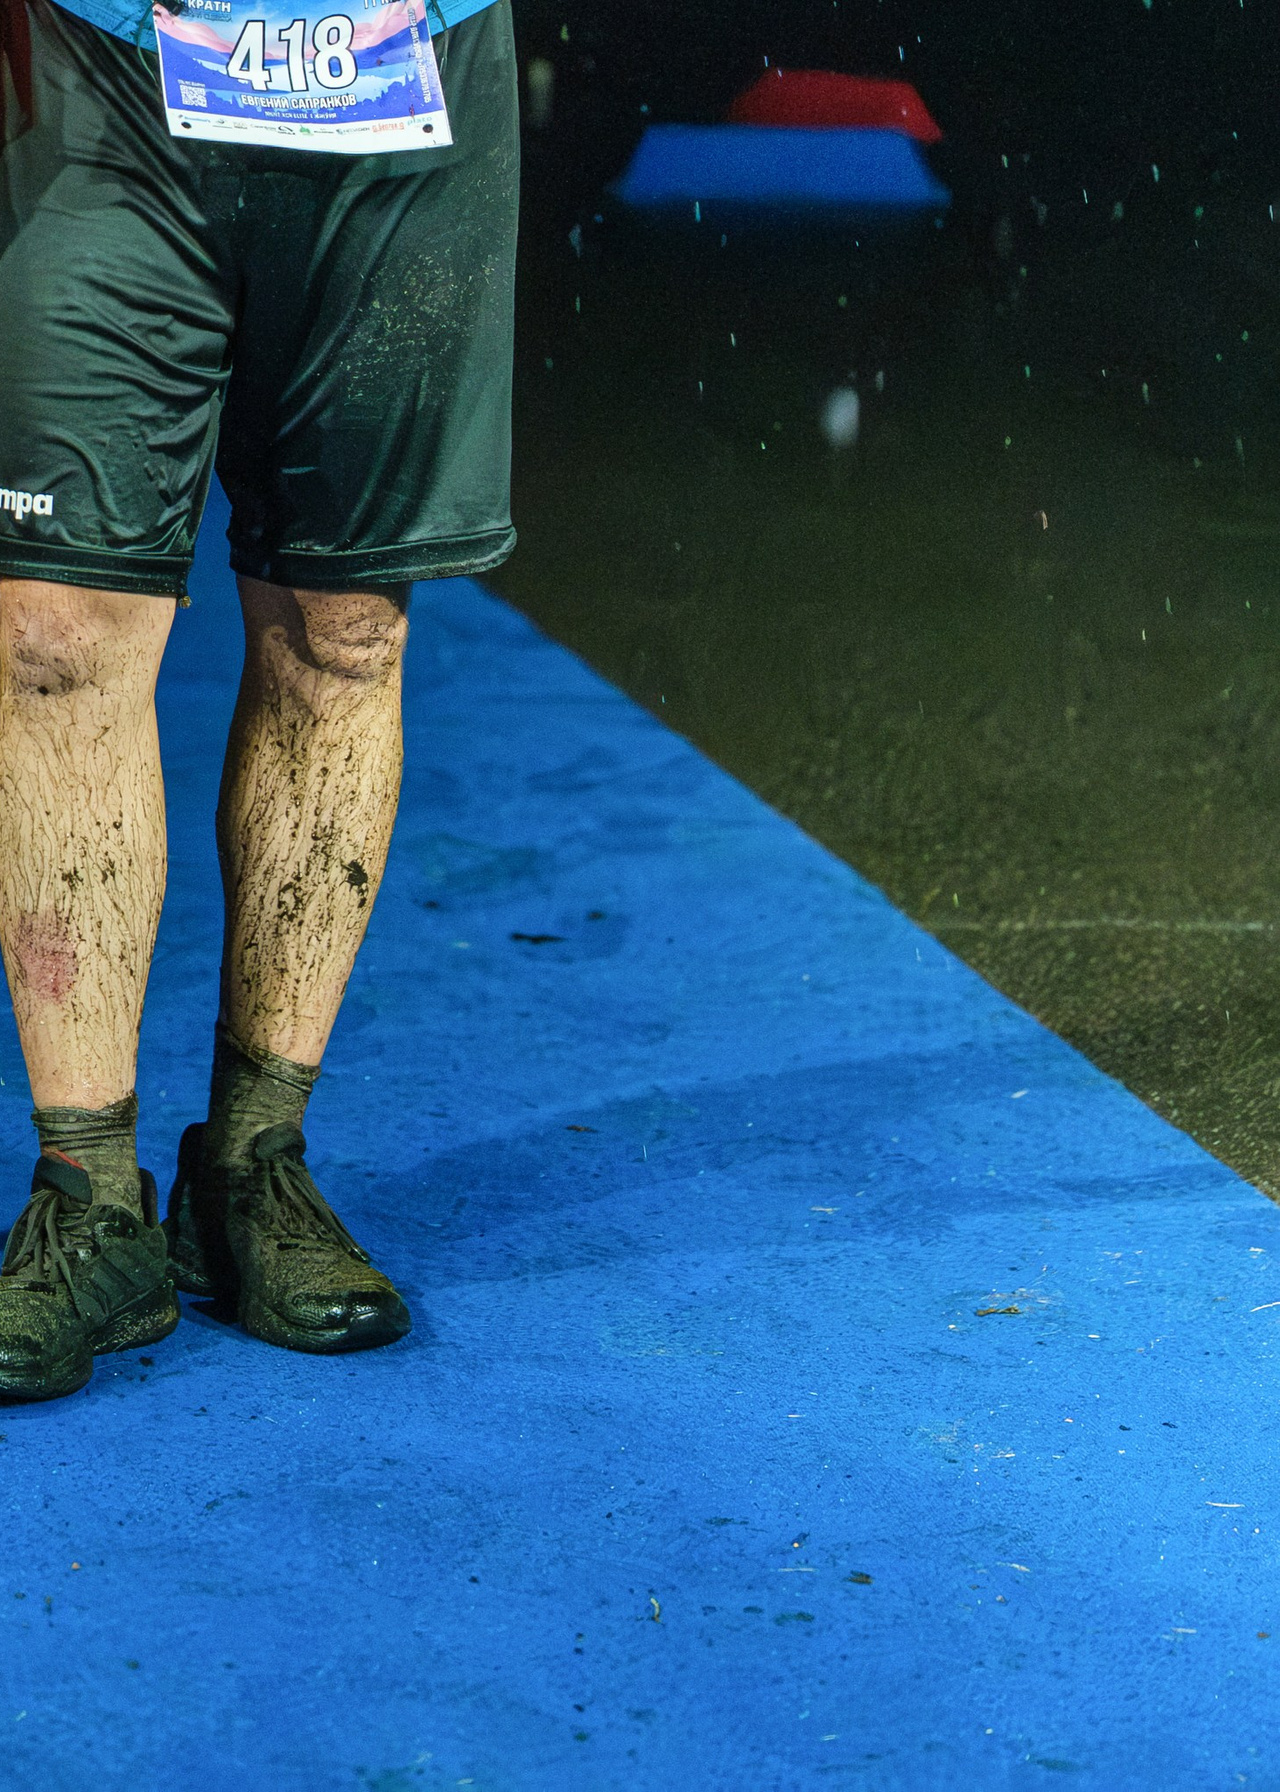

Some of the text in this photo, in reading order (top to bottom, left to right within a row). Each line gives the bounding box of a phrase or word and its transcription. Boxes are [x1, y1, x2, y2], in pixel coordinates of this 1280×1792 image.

[225, 14, 358, 92] 418
[240, 94, 357, 110] ЕВГЕНИЙ САПРАНКОВ
